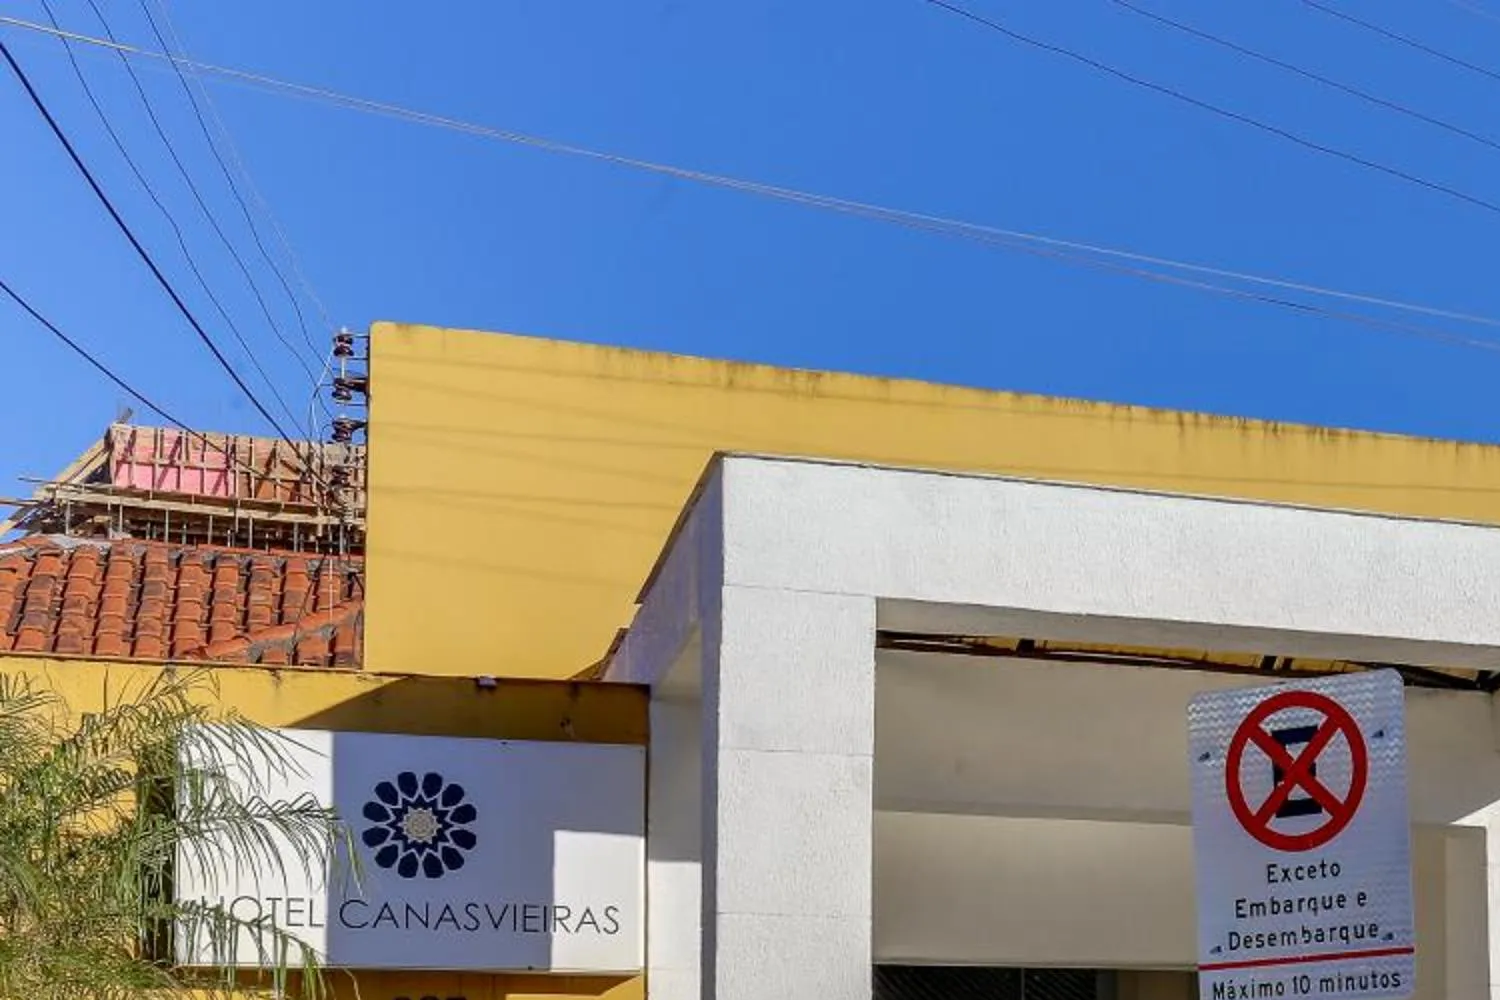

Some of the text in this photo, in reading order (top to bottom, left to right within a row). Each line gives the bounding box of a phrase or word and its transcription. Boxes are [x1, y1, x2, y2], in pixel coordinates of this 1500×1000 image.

[1266, 858, 1341, 884] Exceto
[339, 899, 620, 934] CANASVIEIRAS
[1235, 891, 1369, 919] Embarque e
[1228, 922, 1379, 951] Desembarque
[1213, 970, 1402, 1000] Máximo 10 minutos
